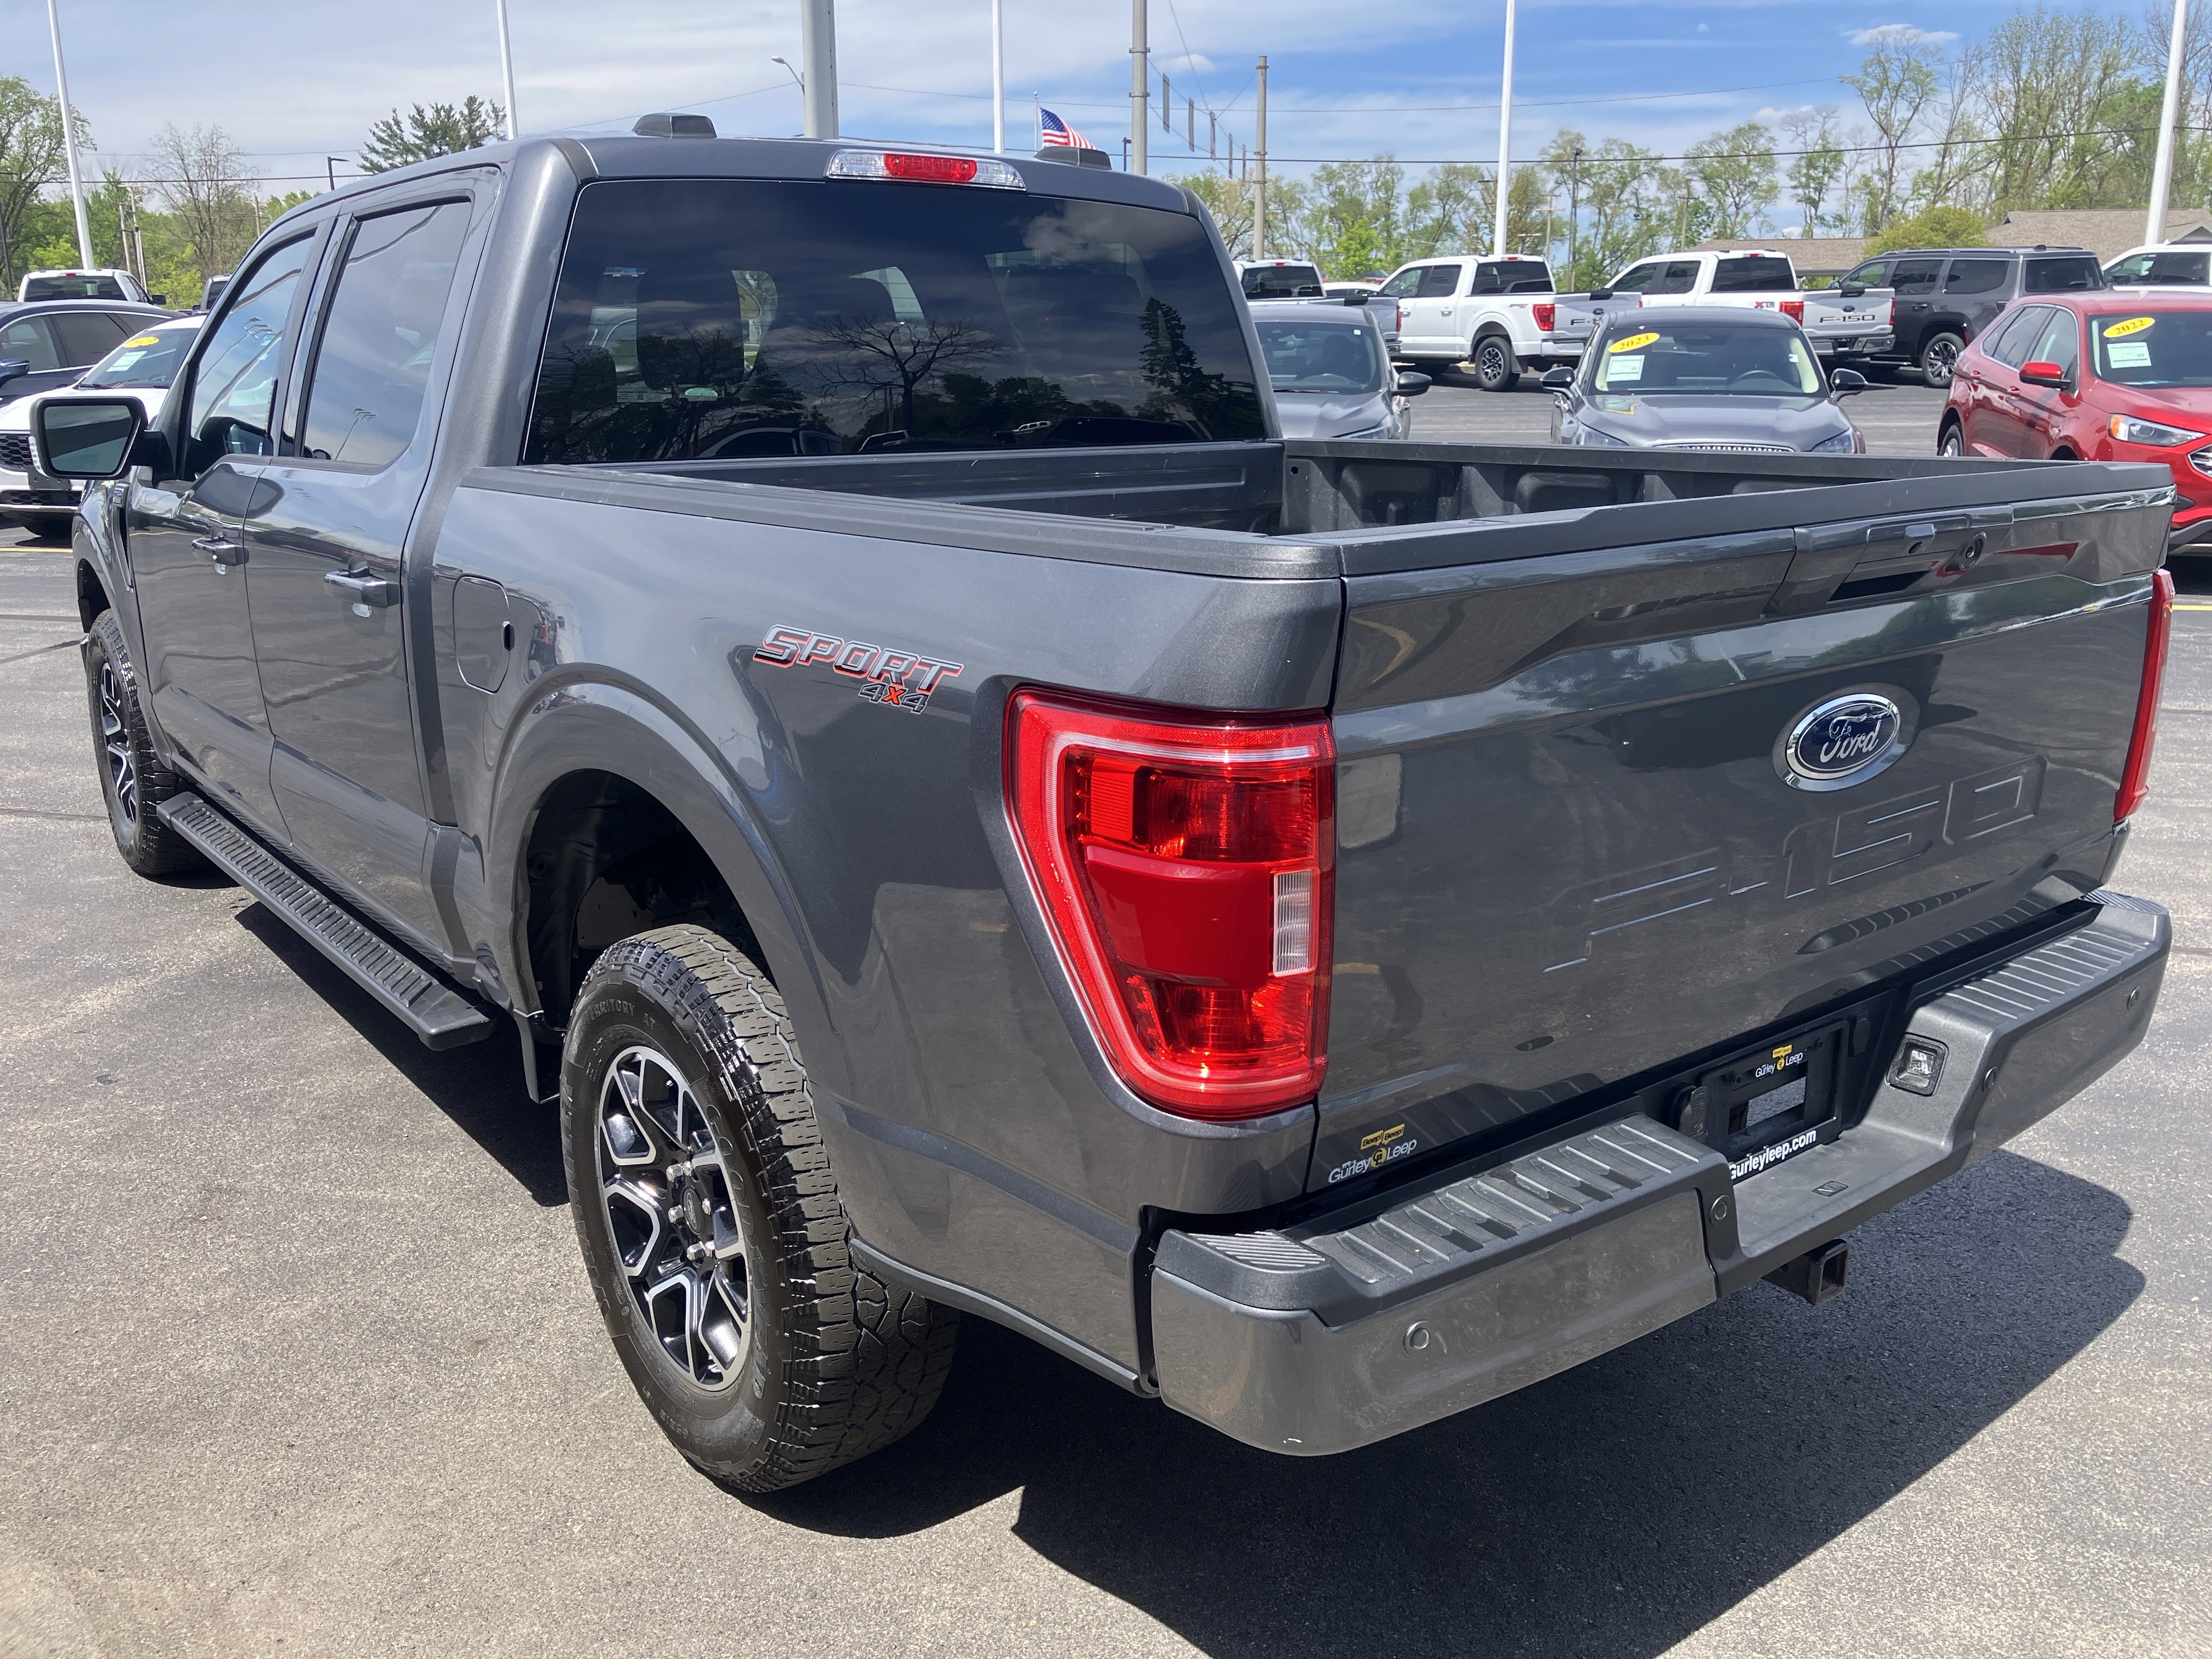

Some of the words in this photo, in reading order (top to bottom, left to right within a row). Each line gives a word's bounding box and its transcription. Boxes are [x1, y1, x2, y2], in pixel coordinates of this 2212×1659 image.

[1820, 315, 1875, 323] F-150
[2114, 320, 2145, 335] 2022
[1620, 335, 1649, 350] 2023
[753, 624, 964, 694] SPORT
[1820, 713, 1882, 763] Ford
[1542, 755, 2047, 973] F-150
[1756, 1063, 1776, 1078] Gurley
[1785, 1052, 1803, 1066] Leep
[1362, 1132, 1383, 1147] Beep!
[1384, 1126, 1404, 1141] Beep!
[1328, 1157, 1371, 1183] Gurley
[1387, 1139, 1417, 1160] Leep
[1729, 1130, 1817, 1180] Gurleyleep.com
